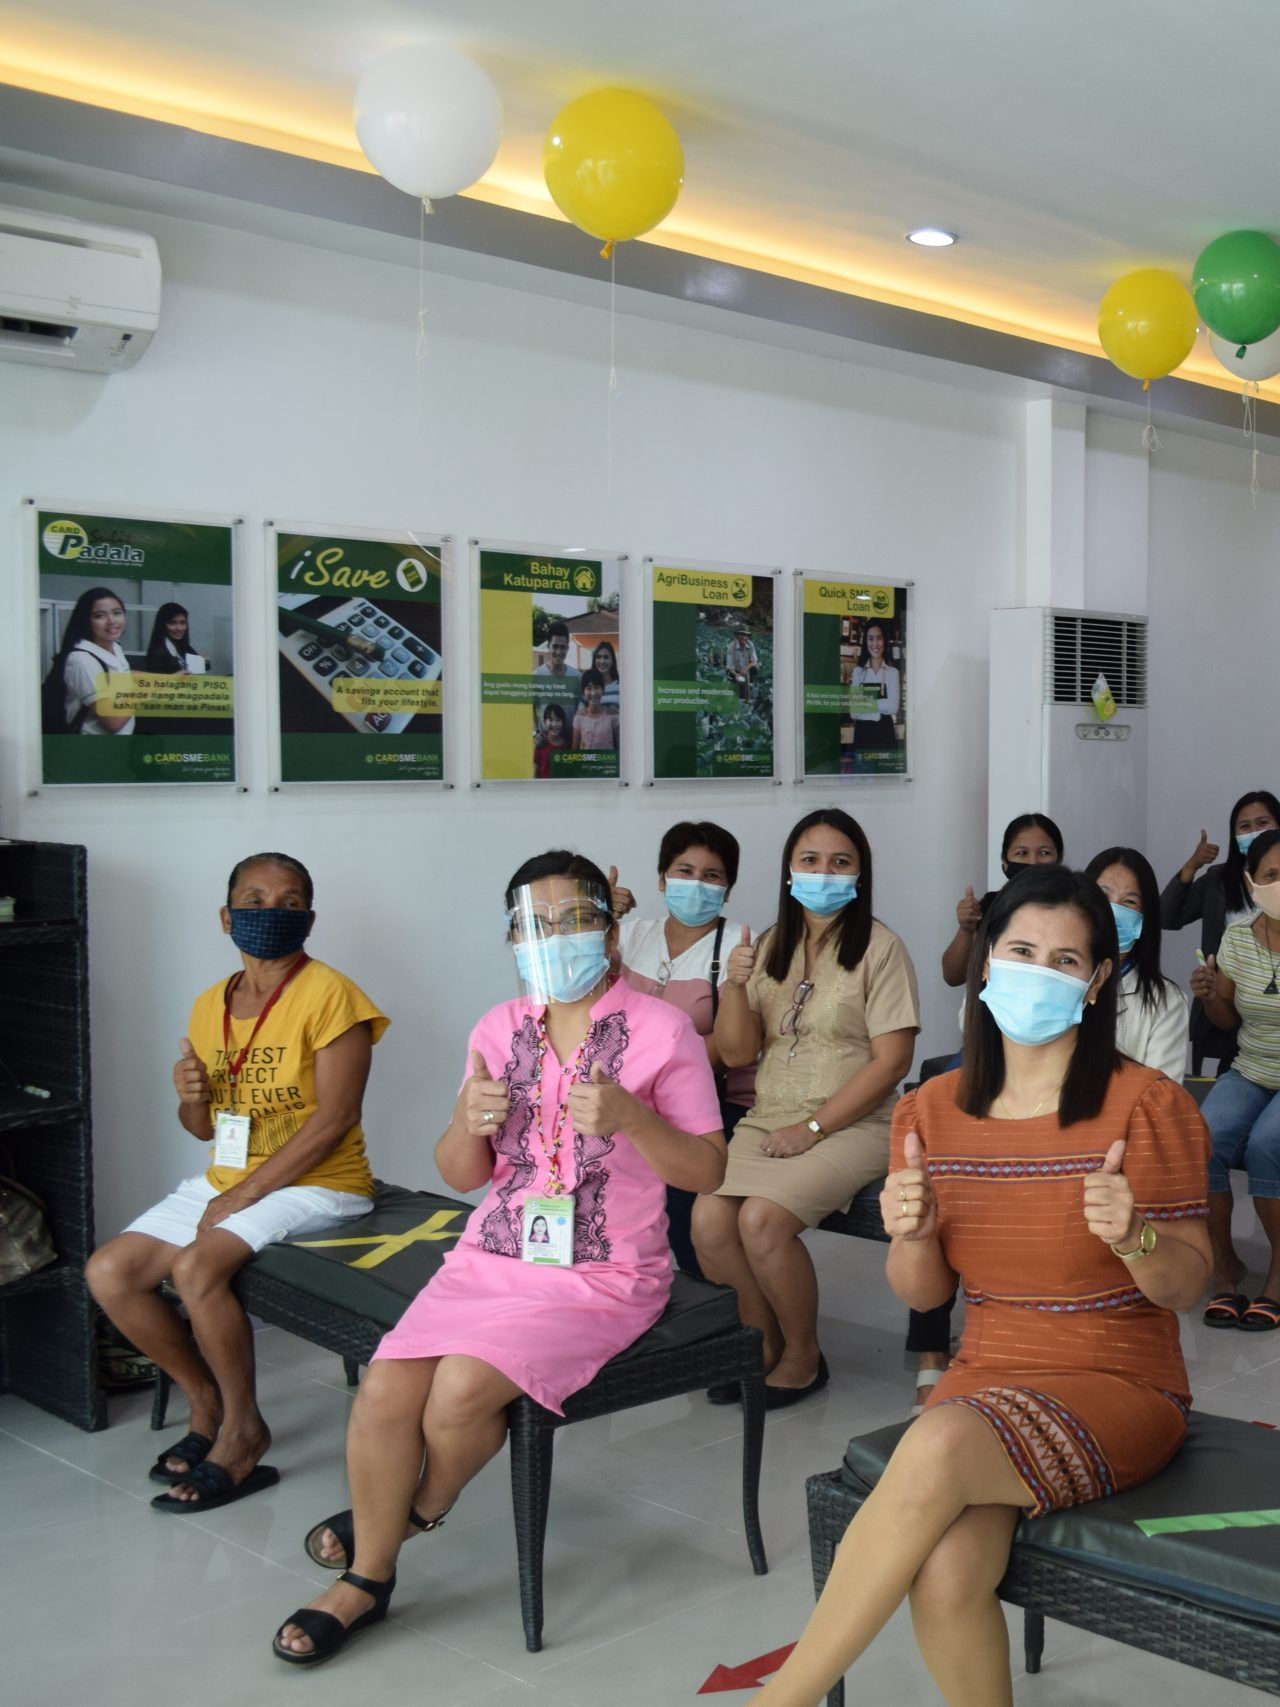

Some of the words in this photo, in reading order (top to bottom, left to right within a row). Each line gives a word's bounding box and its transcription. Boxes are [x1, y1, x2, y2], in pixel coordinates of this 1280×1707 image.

[50, 525, 80, 534] CARD
[58, 534, 145, 562] Padala
[531, 562, 570, 580] Bahay
[503, 573, 570, 591] Katuparan
[657, 571, 729, 589] AgriBusiness
[702, 587, 729, 601] Loan
[819, 586, 847, 599] Quick
[847, 600, 871, 611] Loan
[139, 680, 151, 688] Sa
[153, 680, 198, 690] halagang
[115, 691, 148, 700] pwede
[151, 692, 175, 701] nang
[177, 691, 230, 701] magpadala
[345, 687, 380, 696] savings
[383, 688, 420, 696] account
[422, 688, 440, 696] that
[657, 687, 687, 695] Increase
[701, 688, 734, 696] modernize
[113, 702, 138, 711] kahit
[163, 703, 184, 711] man
[361, 697, 376, 705] fits
[379, 699, 399, 708] your
[251, 1086, 302, 1104] EVER
